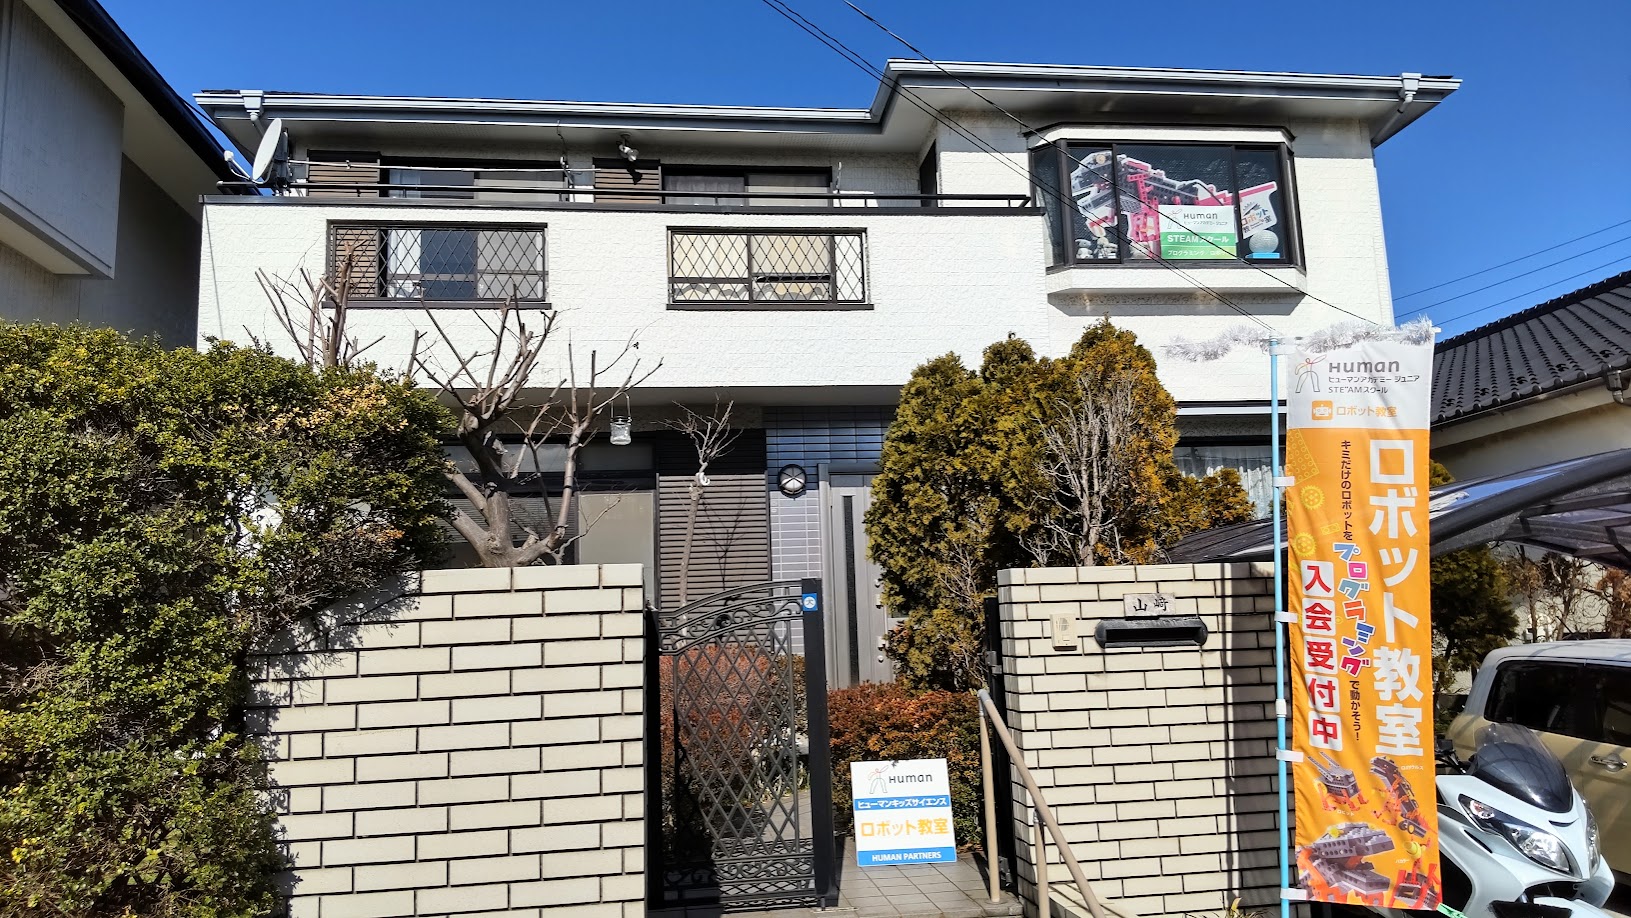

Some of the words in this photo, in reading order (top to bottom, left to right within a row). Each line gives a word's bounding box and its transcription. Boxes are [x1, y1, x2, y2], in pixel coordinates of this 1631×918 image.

[1328, 360, 1400, 373] Human
[1394, 375, 1420, 383] ジュニア
[1336, 406, 1398, 418] ロボット教室
[1340, 439, 1353, 541] キミだけのロボットを
[1133, 596, 1169, 612] 山崎
[1368, 438, 1424, 757] ロボット教室
[1332, 542, 1376, 678] プログラミング
[1303, 563, 1340, 746] 入会受付中
[888, 774, 933, 784] Human
[857, 797, 947, 809] ヒューマンキッズサイエンス
[860, 818, 950, 837] ロボット教室
[872, 852, 903, 862] HUMAN
[903, 851, 942, 861] PARTNERS
